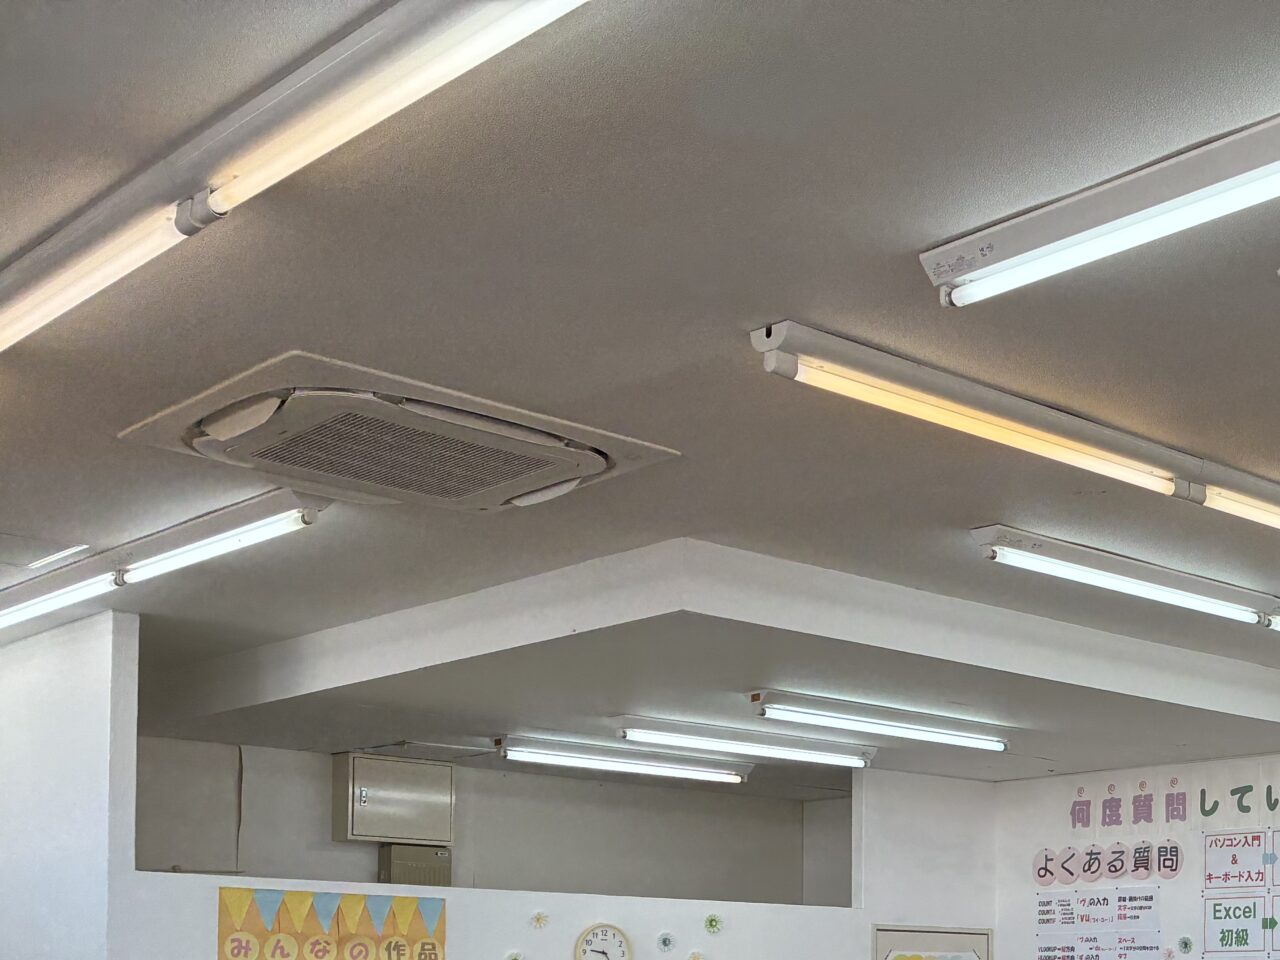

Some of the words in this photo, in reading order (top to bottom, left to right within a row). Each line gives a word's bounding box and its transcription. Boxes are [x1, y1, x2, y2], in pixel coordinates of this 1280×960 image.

[1209, 835, 1261, 848] パソコン入門
[1037, 846, 1179, 879] よくある質問
[1231, 854, 1239, 865] &
[1206, 869, 1264, 882] キーボード入力
[1212, 902, 1257, 920] Excel
[1219, 928, 1249, 947] 初級
